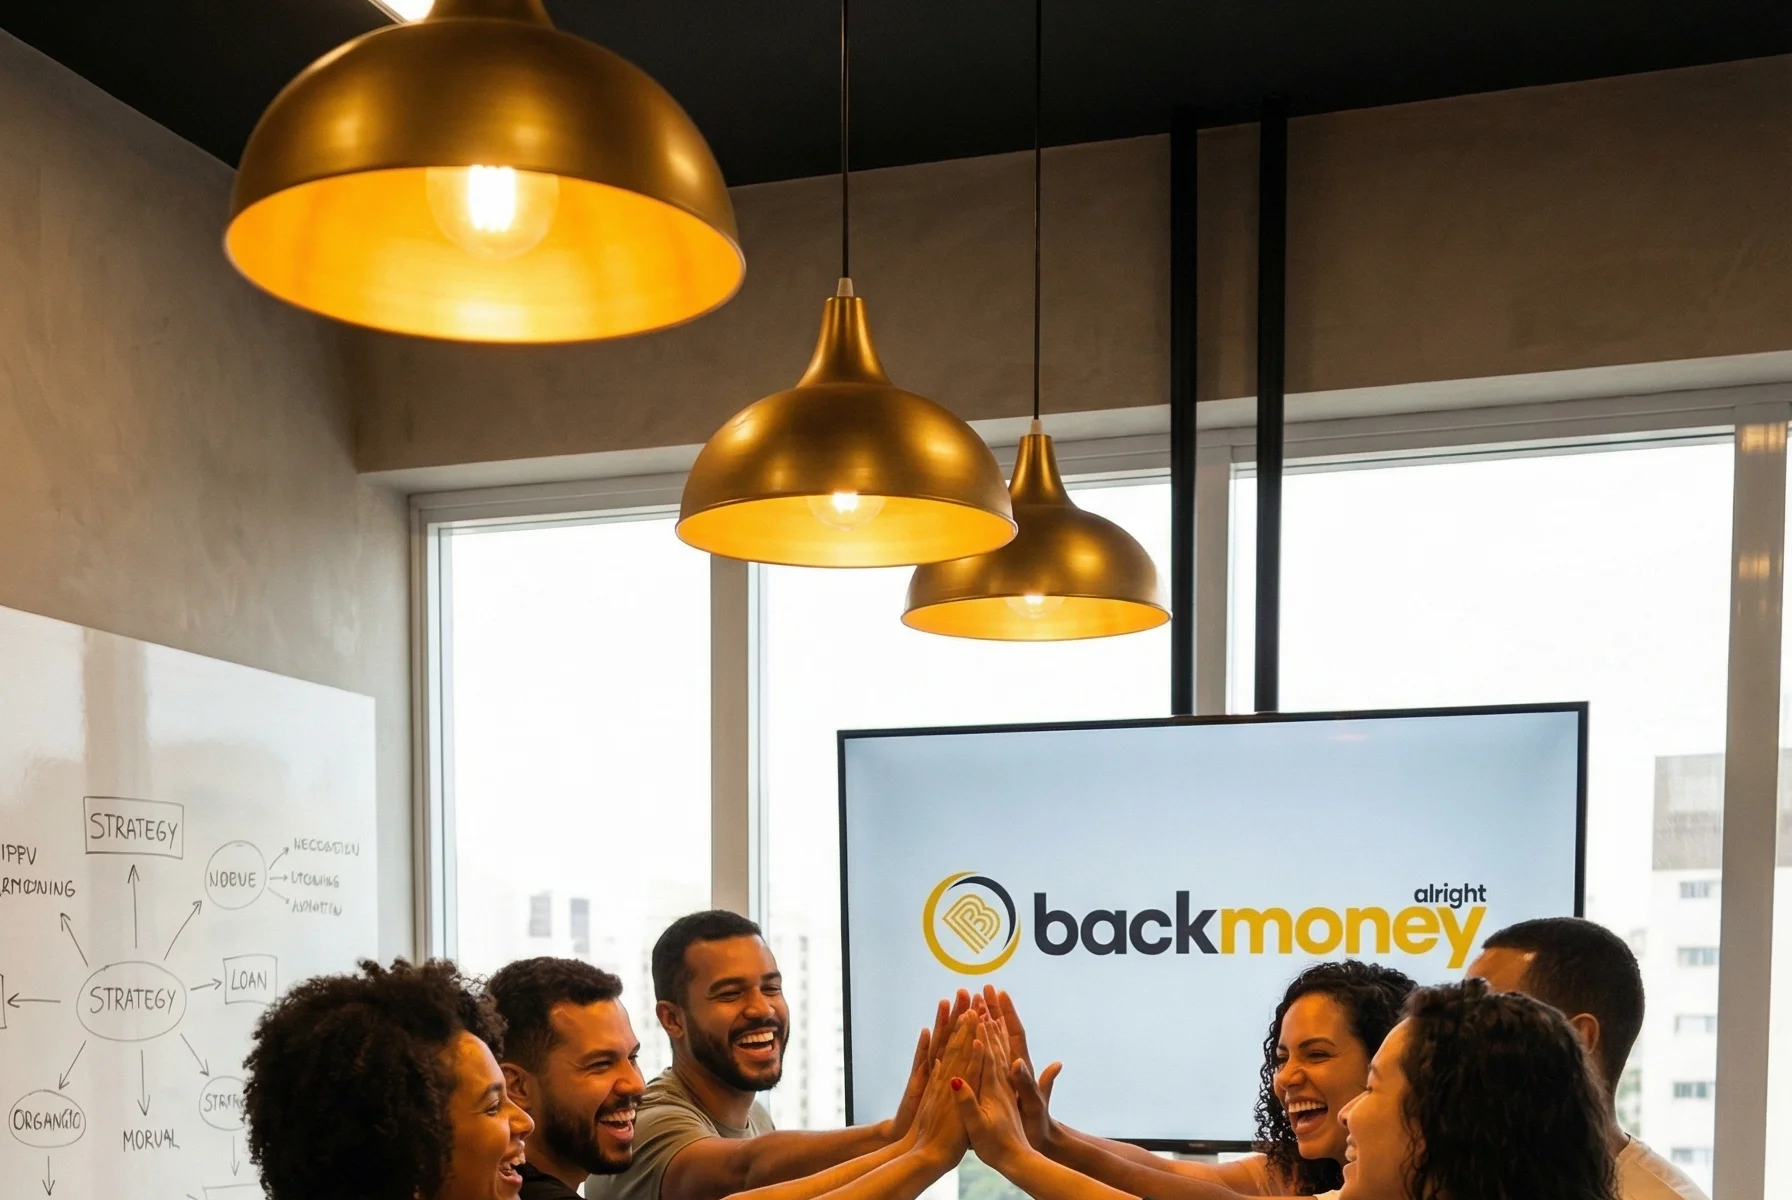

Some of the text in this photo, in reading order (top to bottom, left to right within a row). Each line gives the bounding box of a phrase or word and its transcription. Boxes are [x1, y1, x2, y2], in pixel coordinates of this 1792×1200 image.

[89, 812, 178, 850] STRATEGY
[1413, 882, 1487, 909] alright
[1033, 890, 1487, 969] backmoney
[230, 969, 268, 992] LOAN
[89, 986, 177, 1014] STRATEGY
